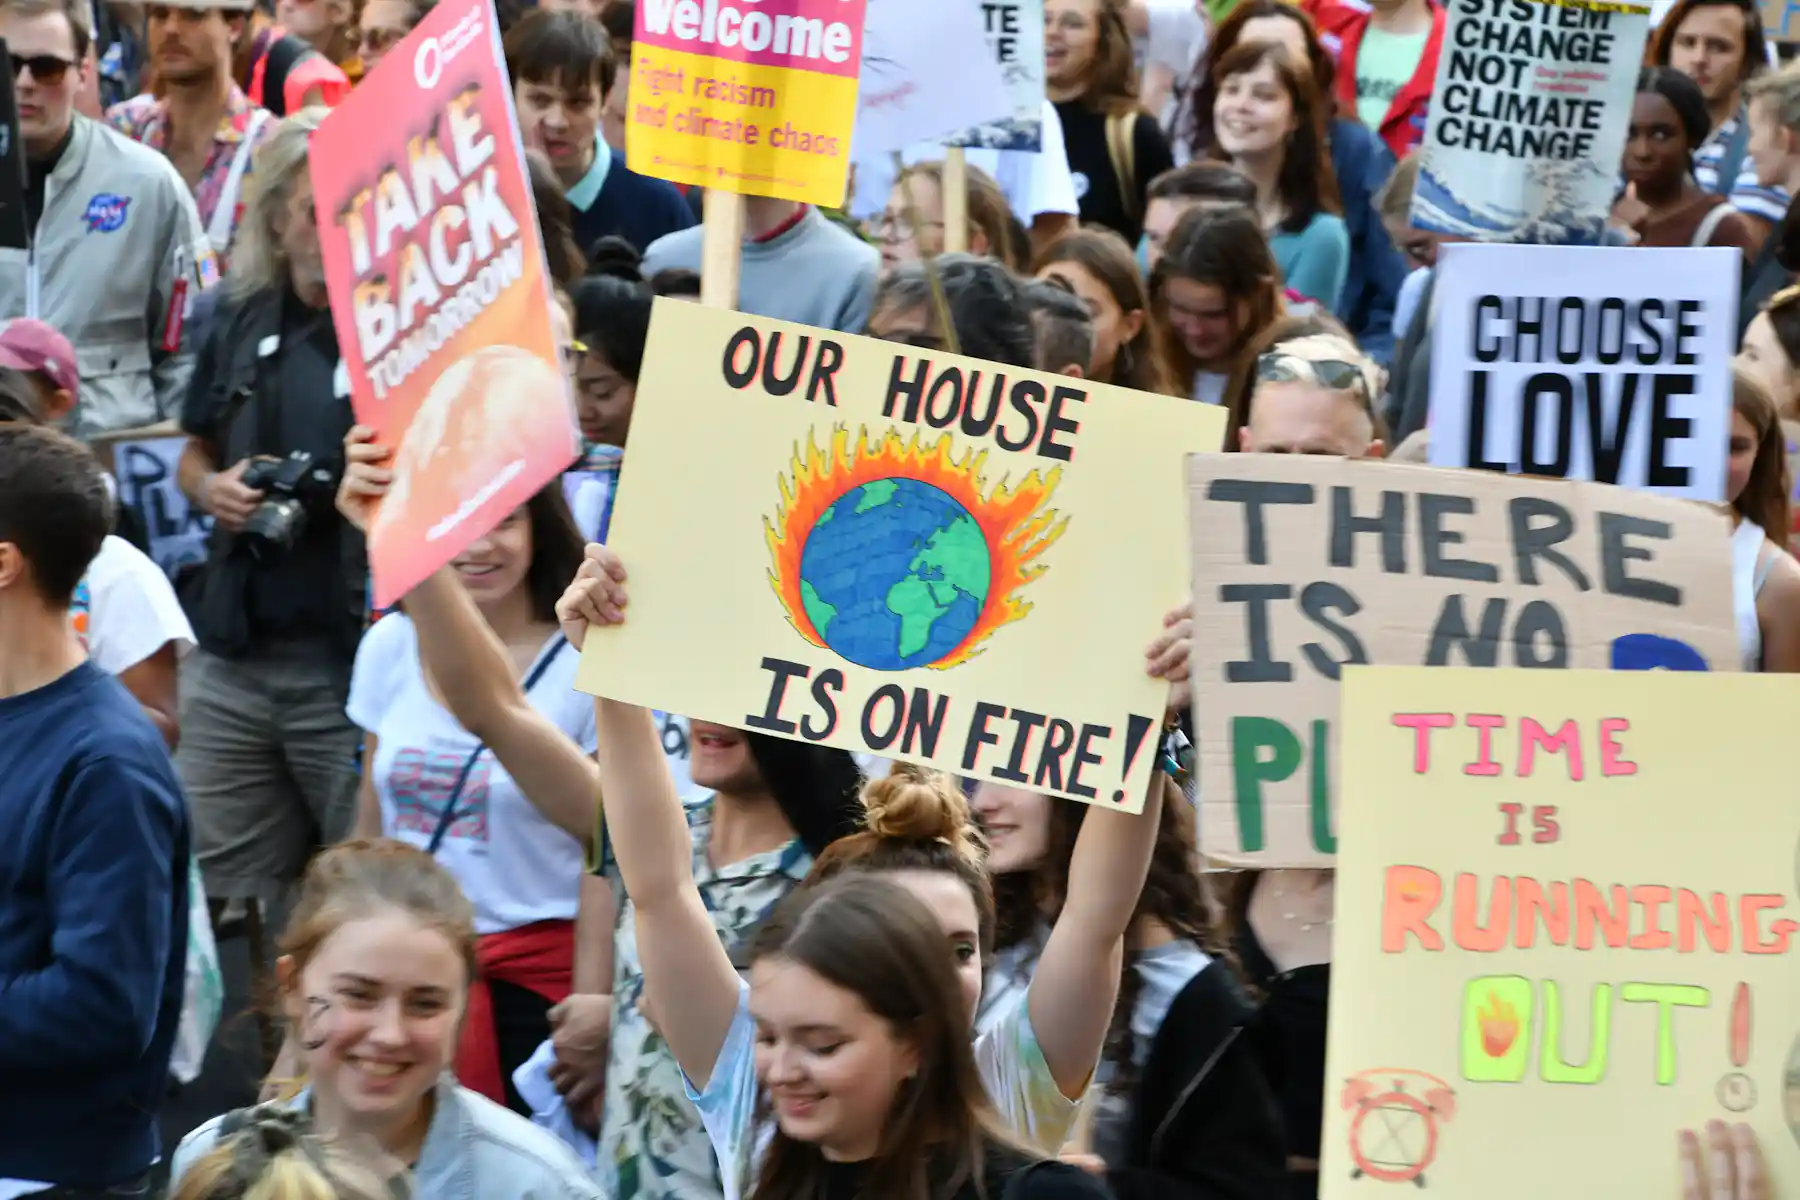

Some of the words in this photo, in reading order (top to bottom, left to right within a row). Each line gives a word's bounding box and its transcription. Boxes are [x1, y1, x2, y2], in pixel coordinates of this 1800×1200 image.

[1449, 49, 1529, 89] NOT
[1455, 17, 1615, 64] CHANGE
[637, 56, 685, 96] Fight
[693, 75, 776, 108] racism
[1442, 84, 1606, 130] CLIMATE
[635, 102, 669, 128] and
[673, 105, 760, 146] climate
[768, 121, 841, 157] chaos
[1436, 117, 1595, 159] CHANGE
[334, 81, 496, 276] TAKE
[354, 165, 519, 363] BACK
[366, 237, 524, 400] TOMORROW
[1473, 294, 1706, 366] CHOOSE
[722, 326, 846, 408] OUR
[882, 355, 1089, 463] HOUSE
[1466, 370, 1699, 488] LOVE
[1207, 479, 1684, 607] THERE
[1220, 581, 1370, 683] IS
[1426, 594, 1569, 668] NO
[745, 656, 846, 742] IS
[861, 683, 952, 760] ON
[961, 701, 1155, 804] FIRE!
[1391, 712, 1638, 782] TIME
[1496, 802, 1561, 846] IS
[1381, 864, 1799, 954] RUNNING
